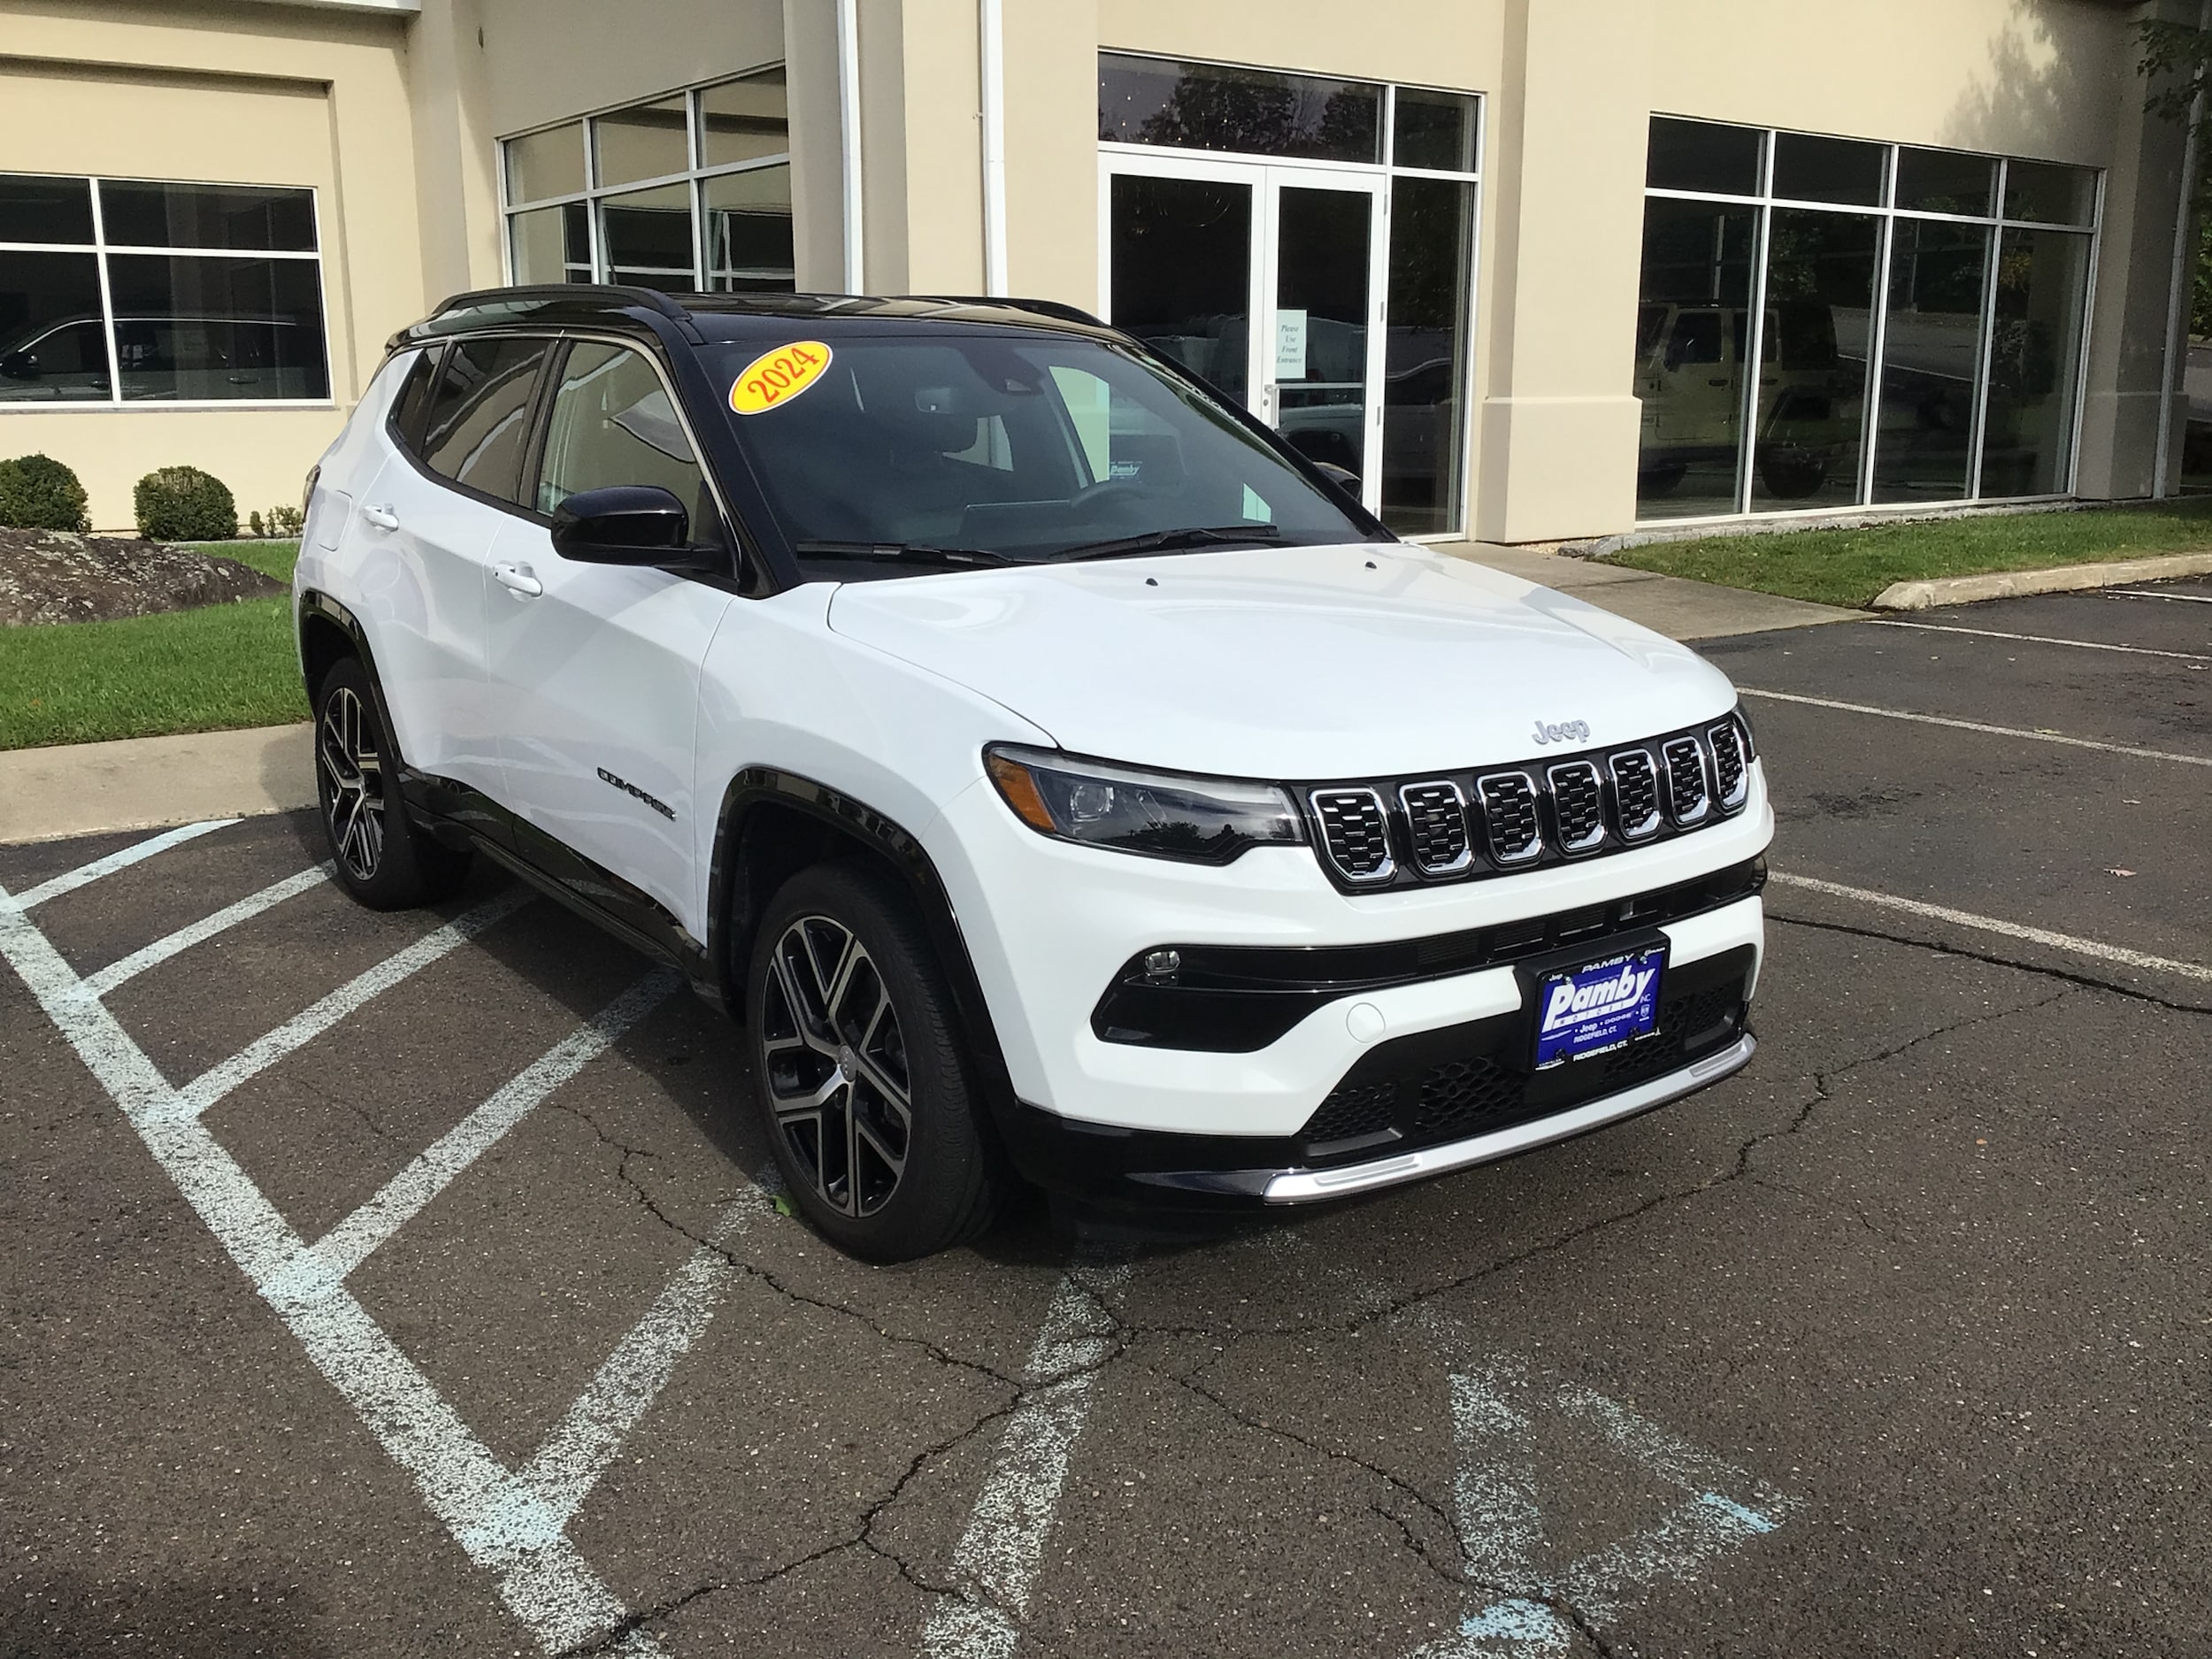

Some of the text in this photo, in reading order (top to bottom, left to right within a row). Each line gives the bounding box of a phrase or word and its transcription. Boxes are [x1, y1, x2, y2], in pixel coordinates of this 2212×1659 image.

[1281, 324, 1300, 333] Please
[747, 347, 820, 403] 2024
[1532, 719, 1591, 745] Jeep
[1581, 953, 1635, 973] PAMBY
[1541, 965, 1656, 1033] Pamby
[1579, 1022, 1598, 1033] Jeep
